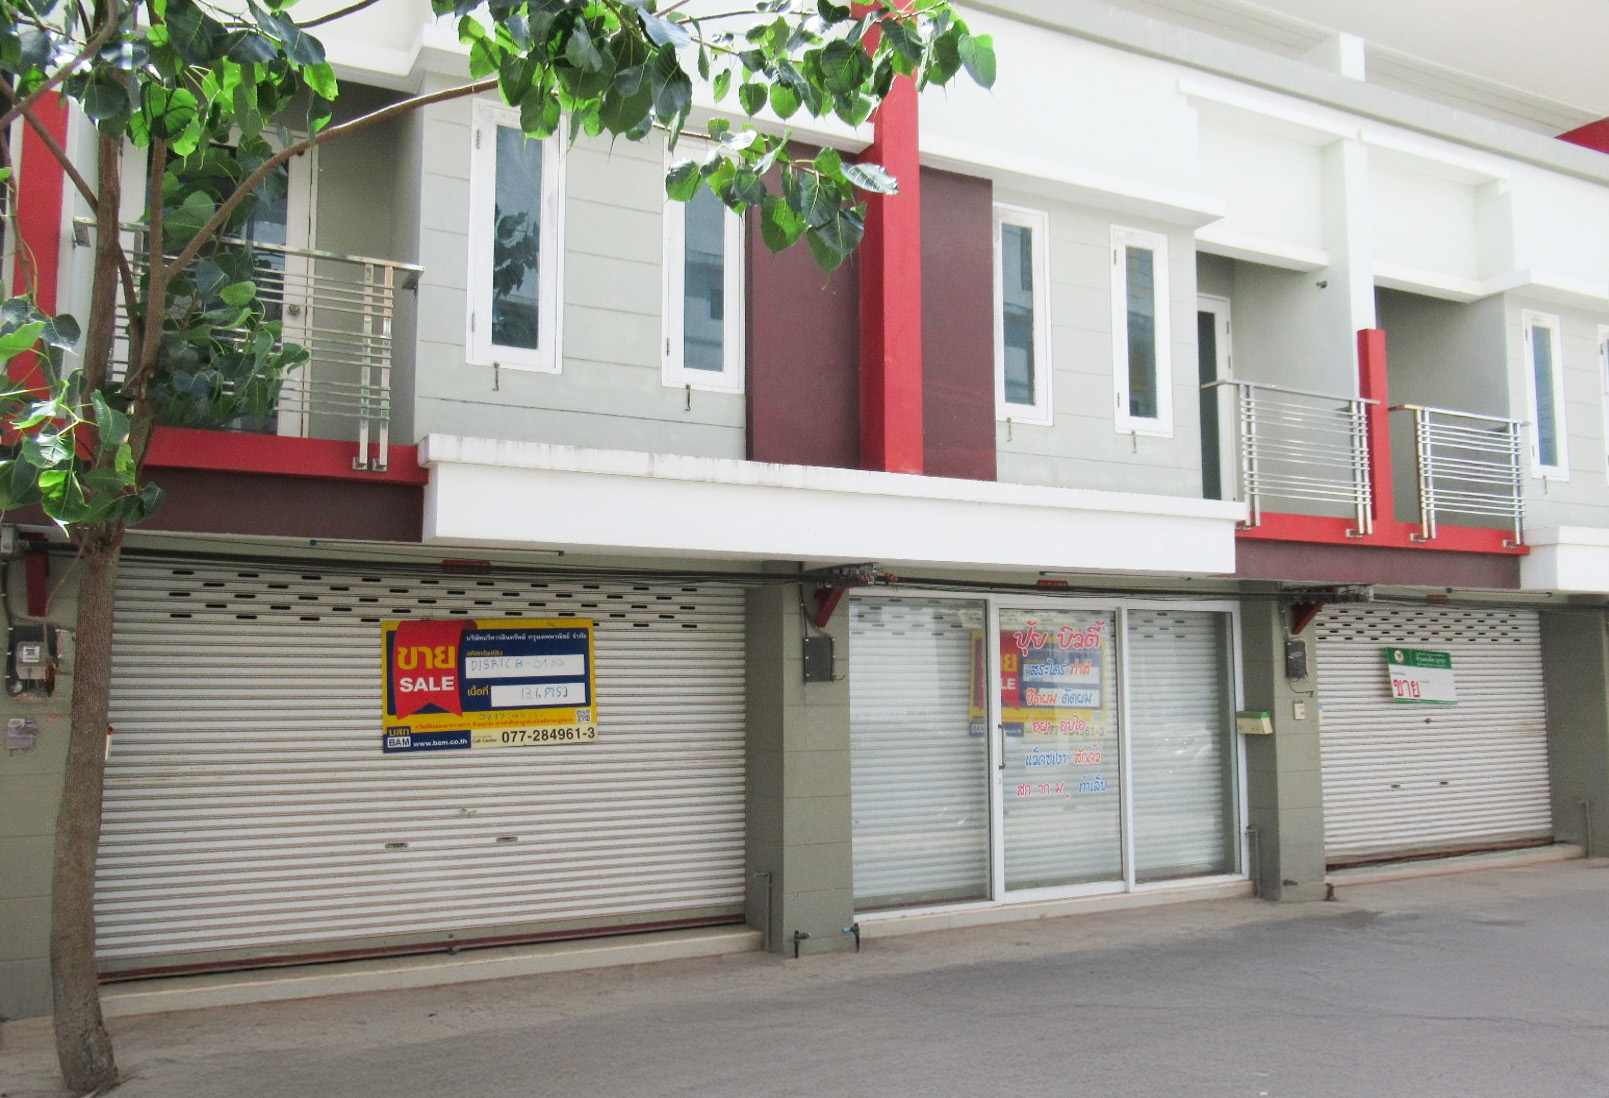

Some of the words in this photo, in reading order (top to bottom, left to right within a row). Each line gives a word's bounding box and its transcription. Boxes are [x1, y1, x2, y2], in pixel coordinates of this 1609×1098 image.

[1013, 620, 1048, 657] ปุ้ย
[1058, 621, 1105, 649] บิวตี้
[397, 646, 456, 670] ขาย
[400, 676, 455, 693] SALE
[467, 685, 489, 696] เนื้อที่
[1393, 680, 1420, 698] ขาย
[1061, 688, 1093, 704] ดัดผม
[388, 737, 410, 747] BAM
[413, 738, 468, 747] www.bam.co.th
[501, 727, 596, 743] 077-284961-3
